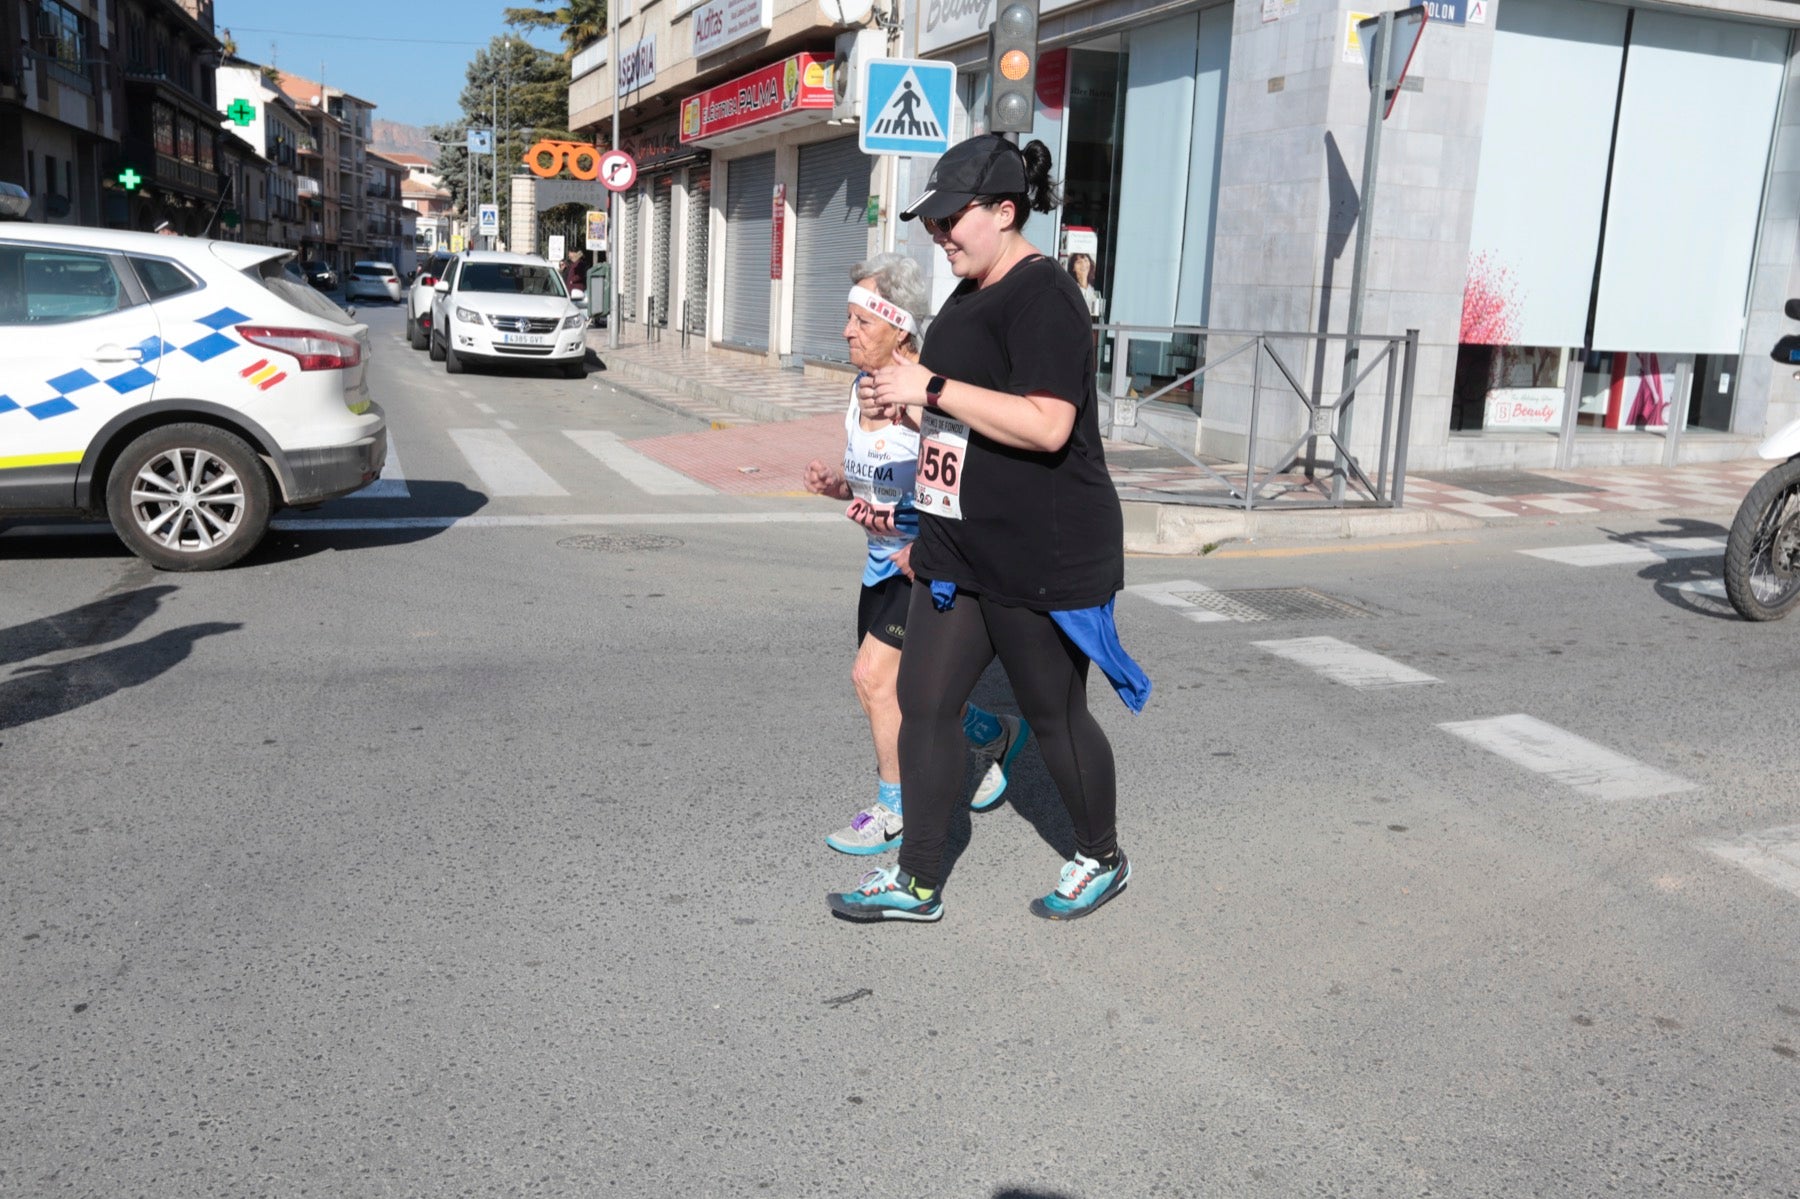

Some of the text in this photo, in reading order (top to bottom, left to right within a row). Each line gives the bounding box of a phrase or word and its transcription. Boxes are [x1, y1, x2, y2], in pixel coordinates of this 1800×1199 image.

[1423, 1, 1456, 20] OLON
[737, 77, 778, 114] PALMA
[1512, 403, 1554, 423] Beauty
[945, 421, 964, 434] FONDO
